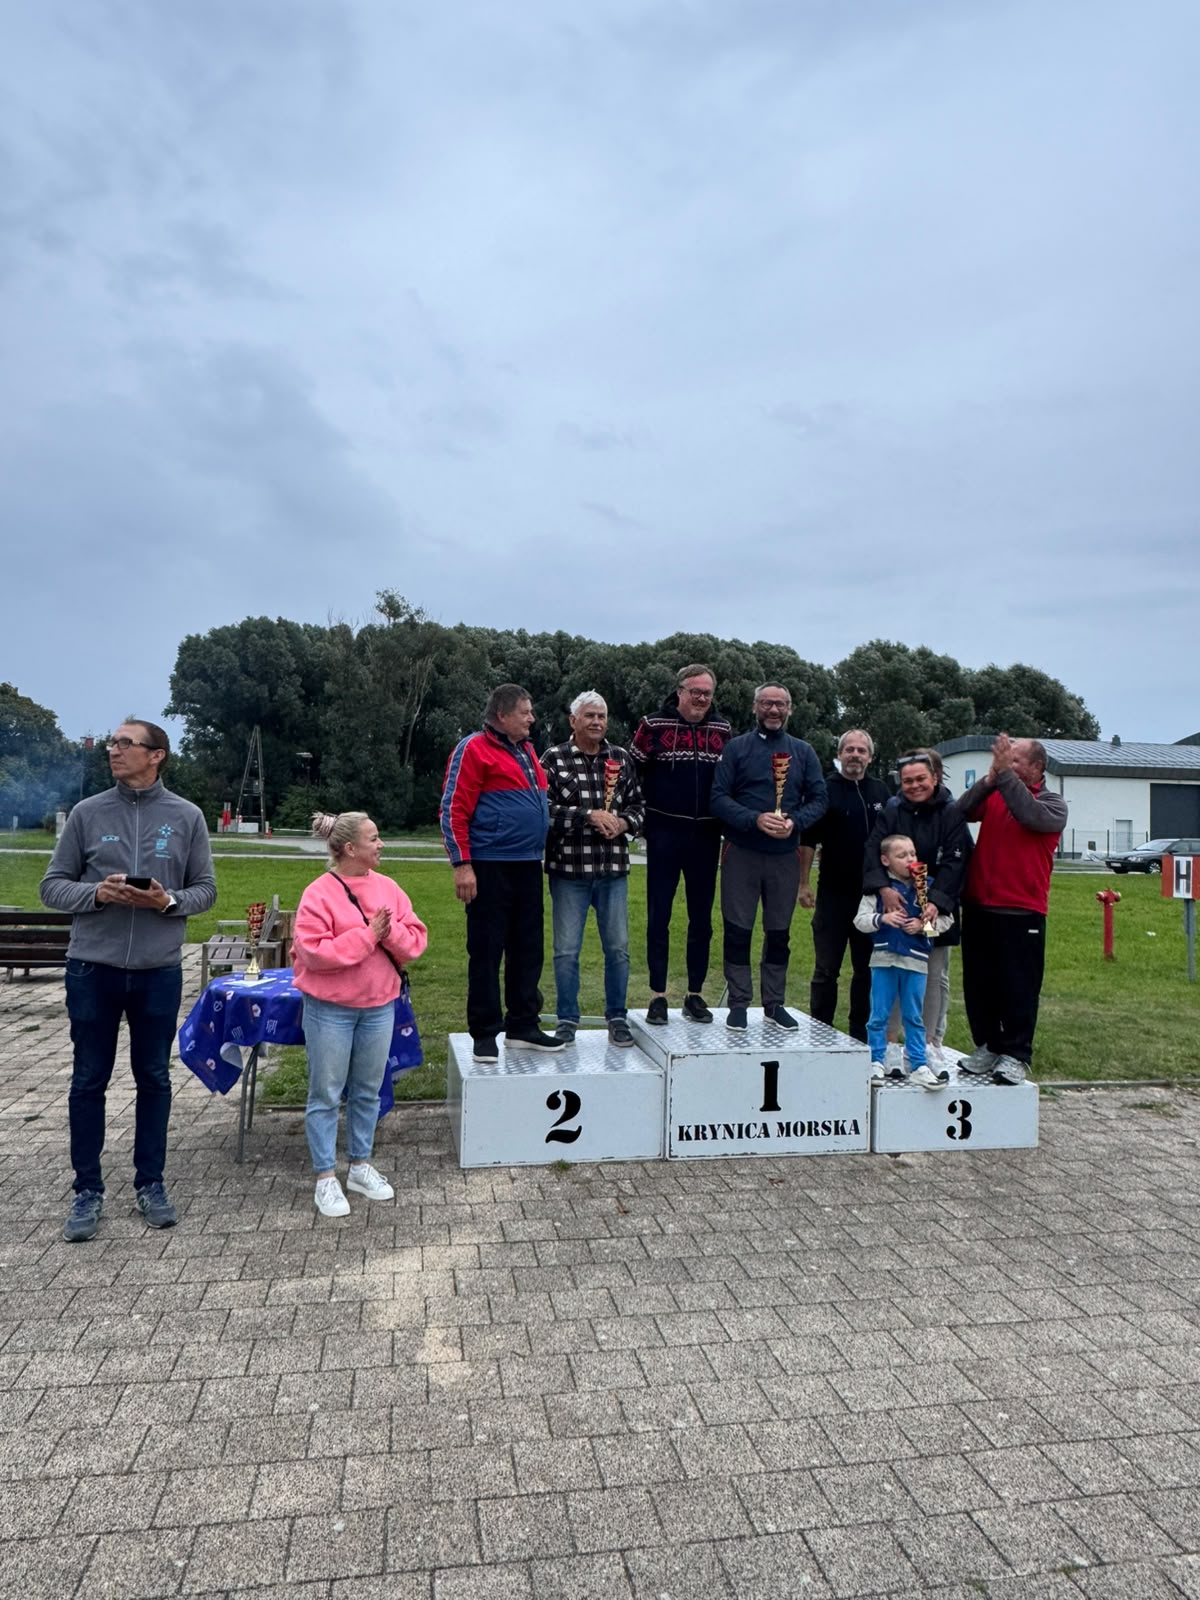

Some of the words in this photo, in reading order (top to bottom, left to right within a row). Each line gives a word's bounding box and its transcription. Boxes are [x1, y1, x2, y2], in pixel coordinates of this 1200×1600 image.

[1175, 860, 1191, 893] H
[760, 1061, 781, 1112] 1
[545, 1089, 582, 1144] 2
[678, 1122, 771, 1142] KRYNICA
[776, 1119, 861, 1138] MORSKA
[946, 1099, 972, 1140] 3
